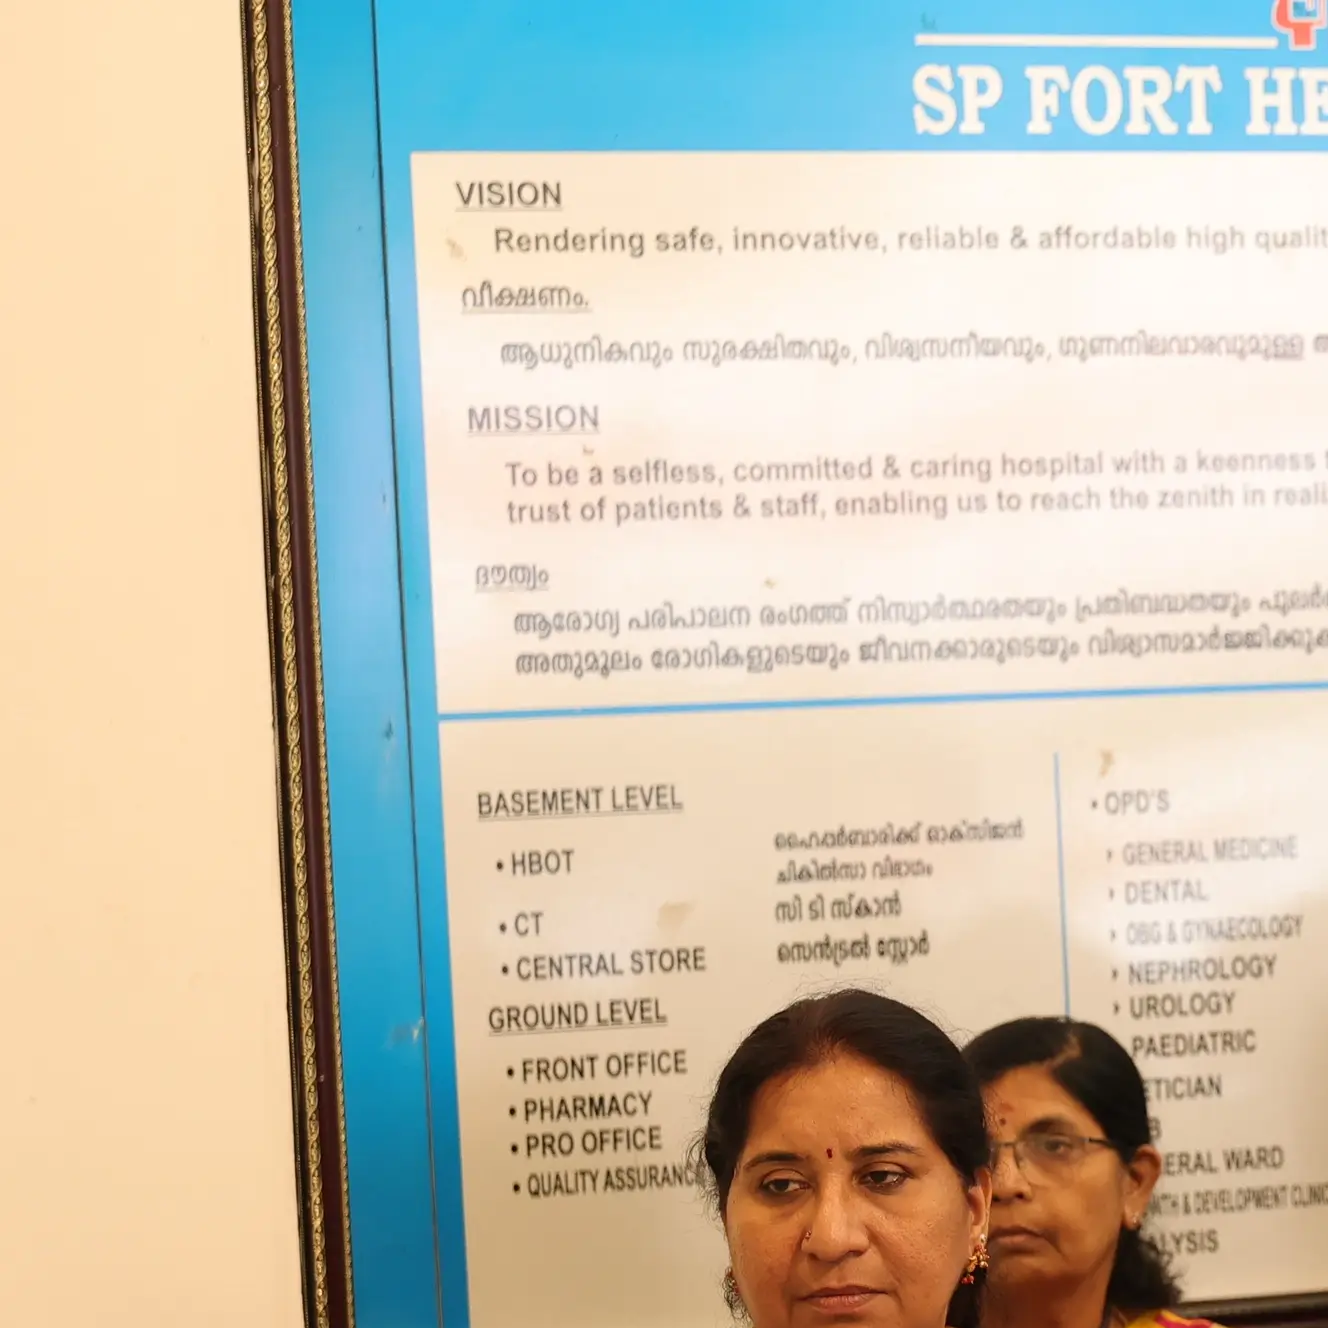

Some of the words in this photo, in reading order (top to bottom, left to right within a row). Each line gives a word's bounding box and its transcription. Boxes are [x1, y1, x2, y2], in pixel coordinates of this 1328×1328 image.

[913, 64, 1003, 136] SP
[1025, 65, 1223, 137] FORT
[455, 181, 563, 208] VISION
[494, 226, 645, 259] Rendering
[655, 225, 723, 255] safe,
[733, 224, 887, 255] innovative,
[897, 224, 999, 251] reliable
[1009, 224, 1029, 250] &
[1039, 224, 1177, 251] affordable
[1185, 224, 1245, 257] high
[467, 404, 600, 432] MISSION
[504, 461, 538, 487] To
[547, 461, 579, 487] be
[589, 465, 603, 486] a
[612, 458, 724, 486] selfless,
[733, 455, 873, 483] committed
[882, 453, 901, 479] &
[910, 452, 992, 484] caring
[1001, 450, 1103, 482] hospital
[1112, 448, 1165, 474] with
[1174, 454, 1188, 474] a
[1196, 447, 1317, 473] keenness
[507, 498, 571, 524] trust
[580, 495, 605, 523] of
[615, 494, 723, 528] patients
[732, 492, 751, 519] &
[760, 491, 826, 521] staff,
[834, 490, 948, 521] enabling
[957, 493, 988, 514] us
[996, 490, 1022, 513] to
[1030, 486, 1101, 512] reach
[1109, 486, 1149, 511] the
[1157, 483, 1234, 509] zenith
[1243, 487, 1266, 507] in
[477, 787, 605, 816] BASEMENT
[611, 783, 683, 811] LEVEL
[1103, 788, 1171, 815] OPD'S
[511, 849, 575, 876] HBOT
[1122, 838, 1208, 866] GENERAL
[1213, 833, 1299, 861] MEDICINE
[1124, 879, 1209, 905] DENTAL
[513, 911, 544, 936] CT
[1126, 920, 1161, 945] OBG
[1182, 915, 1304, 942] GYNAECOLOGY
[516, 952, 623, 980] CENTRAL
[630, 946, 706, 974] STORE
[1128, 954, 1277, 984] NEPHROLOGY
[488, 1001, 589, 1031] GROUND
[596, 998, 667, 1025] LEVEL
[1129, 992, 1236, 1020] UROLOGY
[1131, 1029, 1257, 1059] PAEDIATRIC
[521, 1055, 598, 1083] FRONT
[605, 1049, 688, 1078] OFFICE
[523, 1091, 653, 1122] PHARMACY
[526, 1130, 574, 1158] PRO
[581, 1125, 663, 1155] OFFICE
[1222, 1144, 1286, 1171] WARD
[527, 1167, 599, 1198] QUALITY
[1194, 1185, 1288, 1214] DEVELOPMENT
